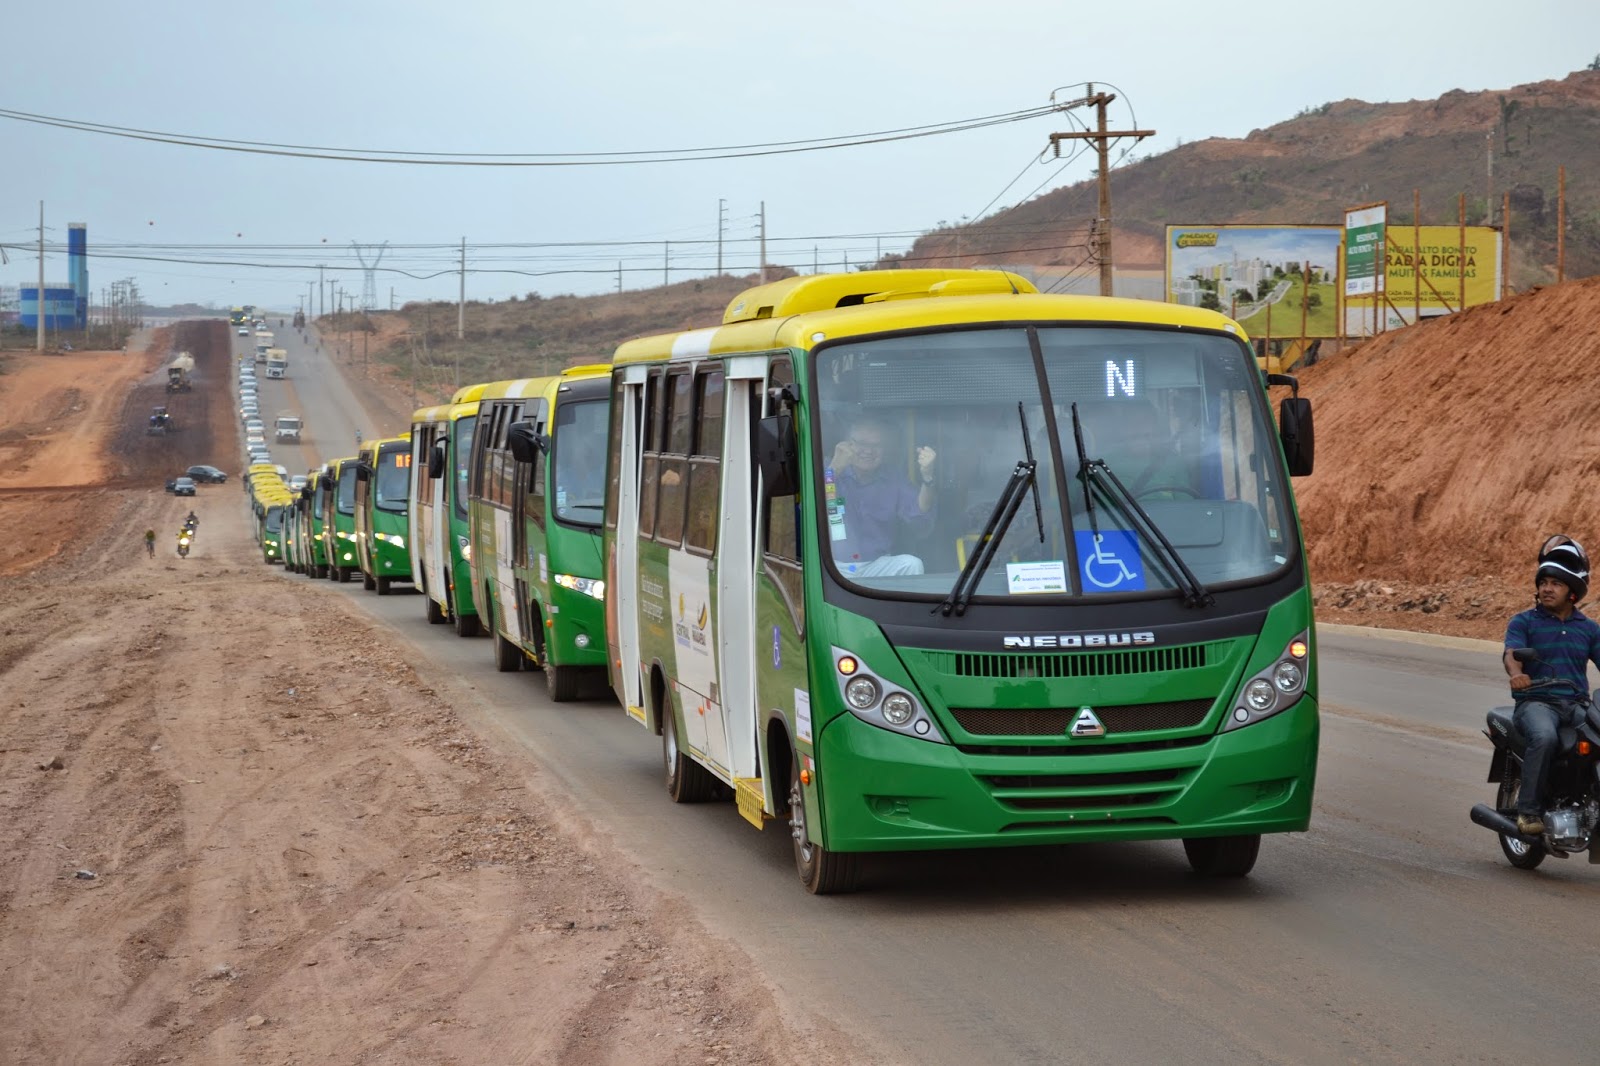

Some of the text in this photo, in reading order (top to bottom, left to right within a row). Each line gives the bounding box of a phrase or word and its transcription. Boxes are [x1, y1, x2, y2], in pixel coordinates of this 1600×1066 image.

[1442, 246, 1477, 255] BONTO
[1389, 269, 1428, 277] MUITS
[1106, 360, 1135, 397] N
[1003, 631, 1155, 648] NEOBUS
